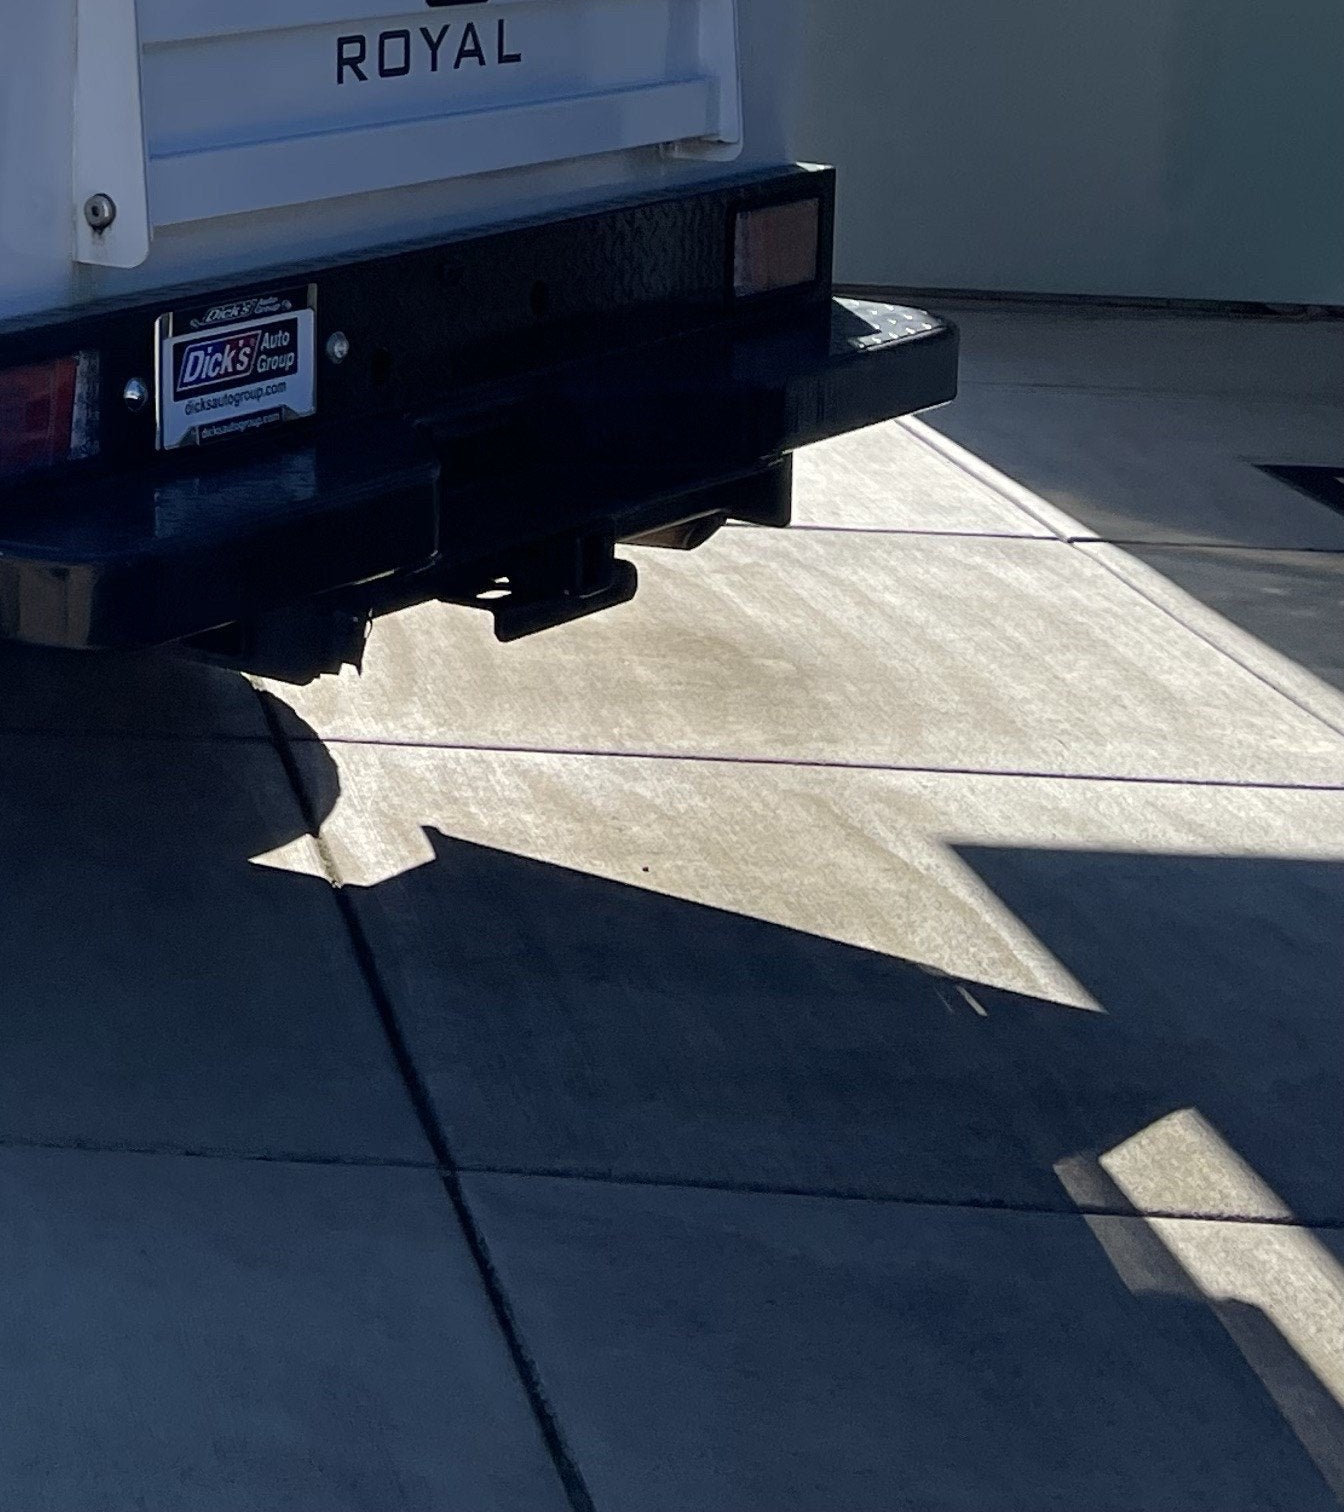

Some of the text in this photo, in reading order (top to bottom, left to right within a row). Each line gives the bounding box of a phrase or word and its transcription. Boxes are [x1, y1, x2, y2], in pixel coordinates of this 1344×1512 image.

[336, 18, 522, 85] ROYAL
[183, 329, 291, 382] Dick's Auto
[257, 351, 296, 374] Group
[184, 380, 288, 416] dicksautogroup.com
